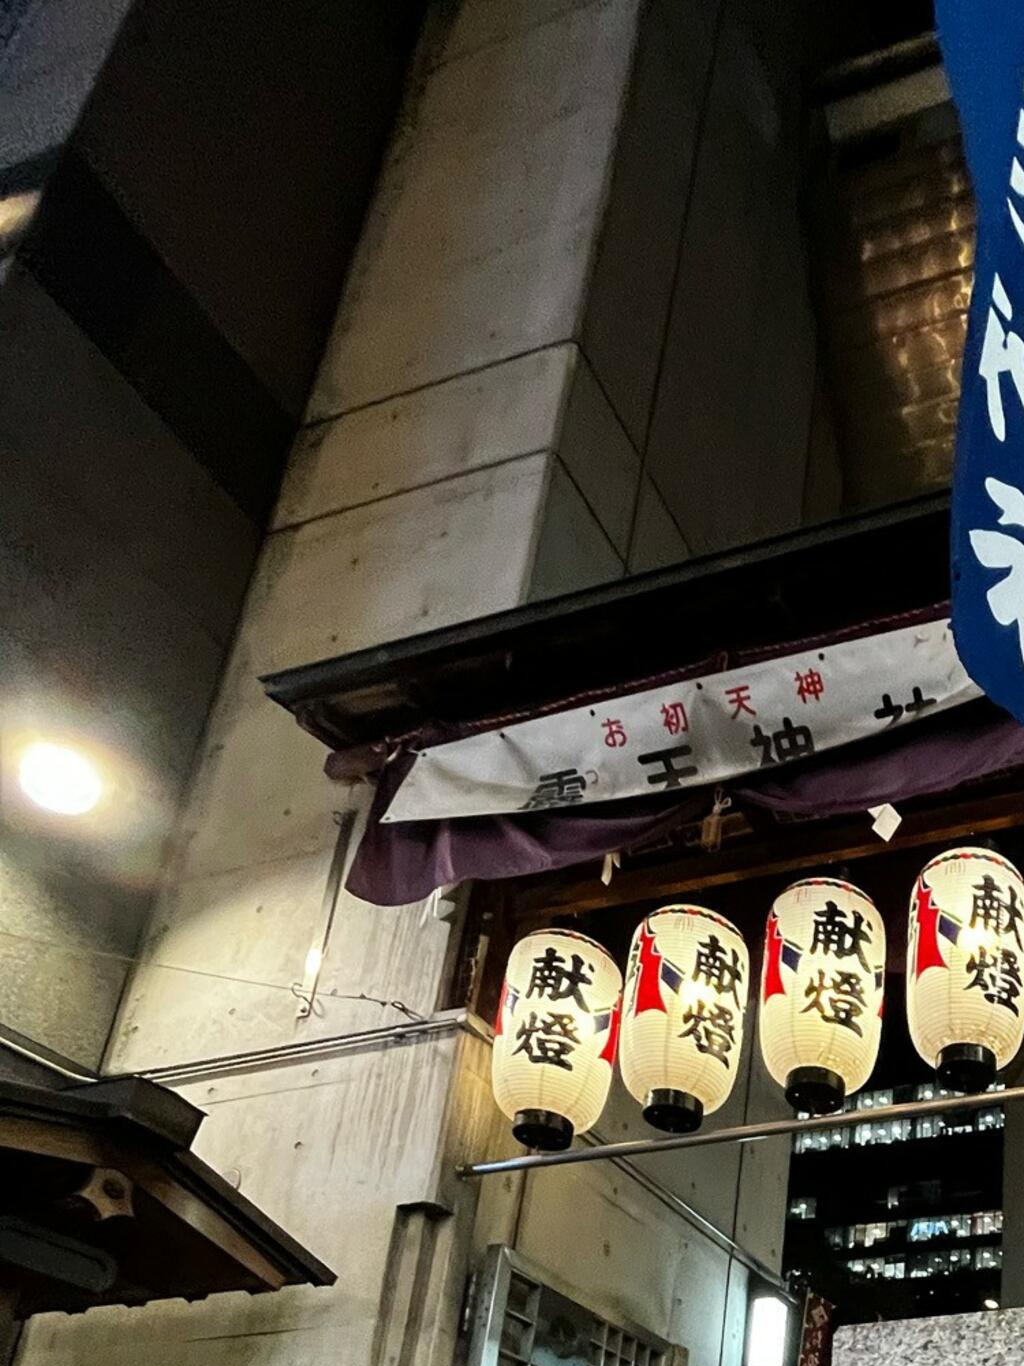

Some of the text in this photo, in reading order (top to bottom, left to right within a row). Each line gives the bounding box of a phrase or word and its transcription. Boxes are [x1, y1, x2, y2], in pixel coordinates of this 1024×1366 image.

[602, 667, 825, 749] お初天神
[512, 947, 595, 1071] 献燈
[678, 934, 745, 1070] 献燈
[801, 900, 874, 1038] 献燈
[964, 873, 1024, 1018] 献燈
